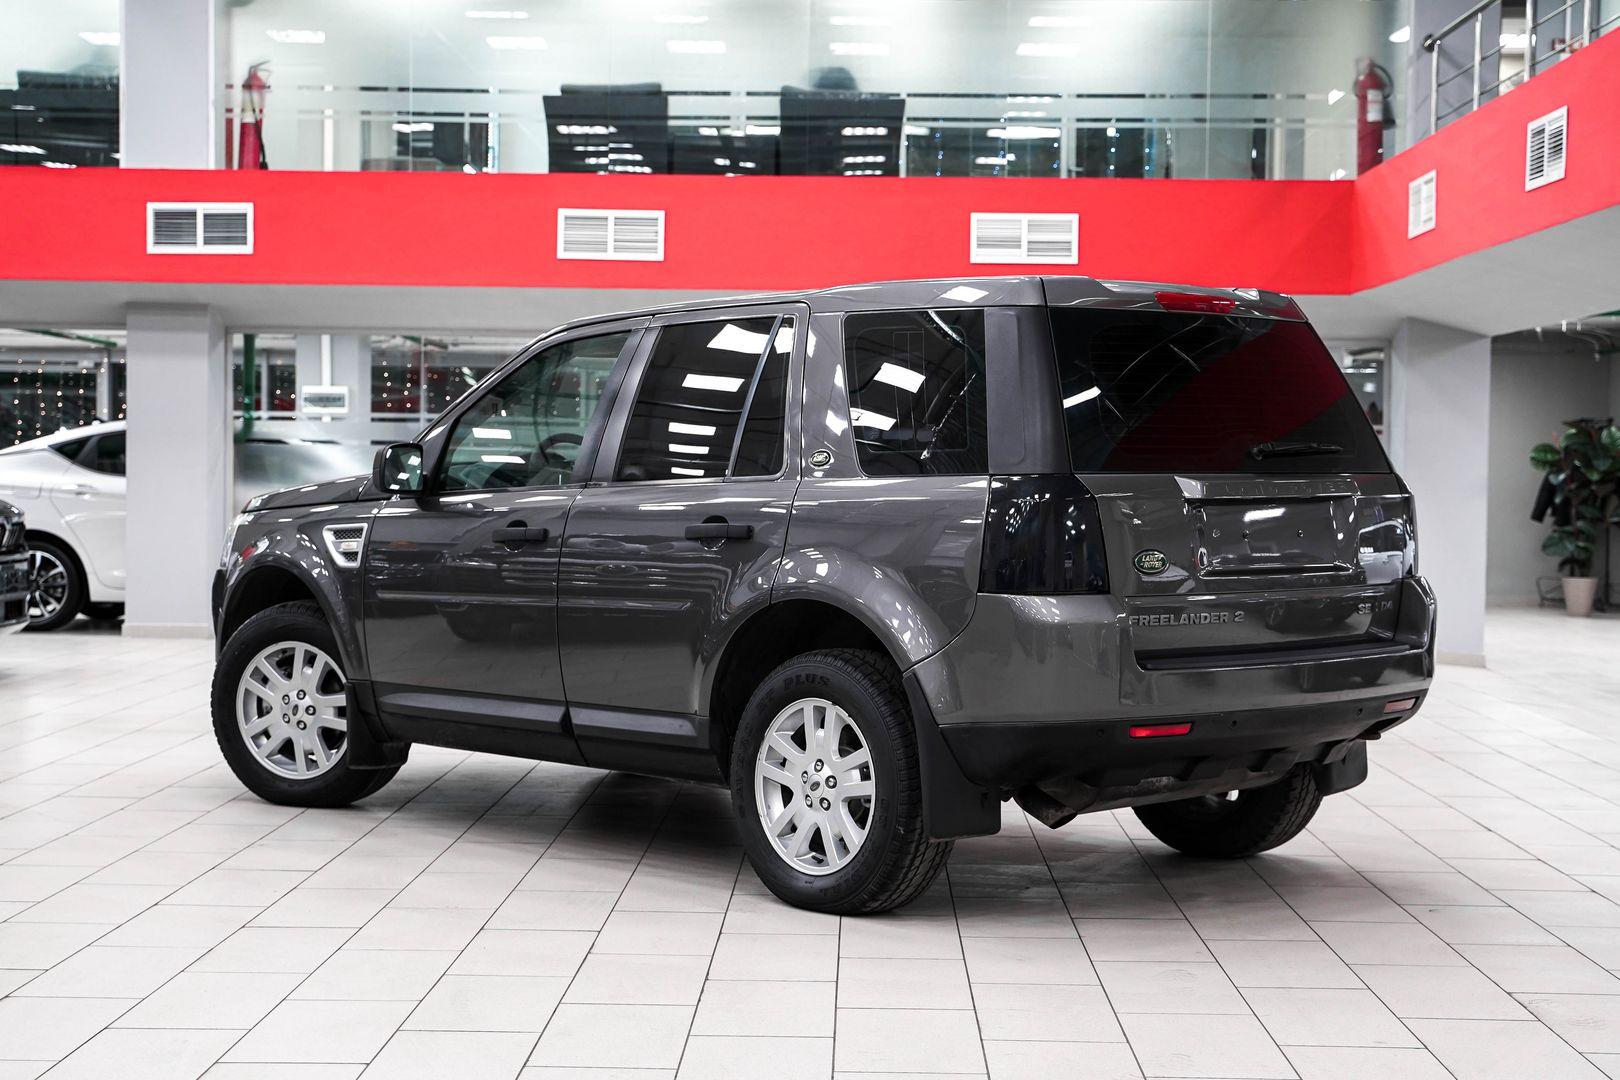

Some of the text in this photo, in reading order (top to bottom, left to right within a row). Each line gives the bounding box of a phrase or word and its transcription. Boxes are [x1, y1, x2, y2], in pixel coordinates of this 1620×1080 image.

[1358, 603, 1372, 614] SE
[1128, 610, 1245, 626] FREELANDER 2
[784, 673, 830, 690] PLUS
